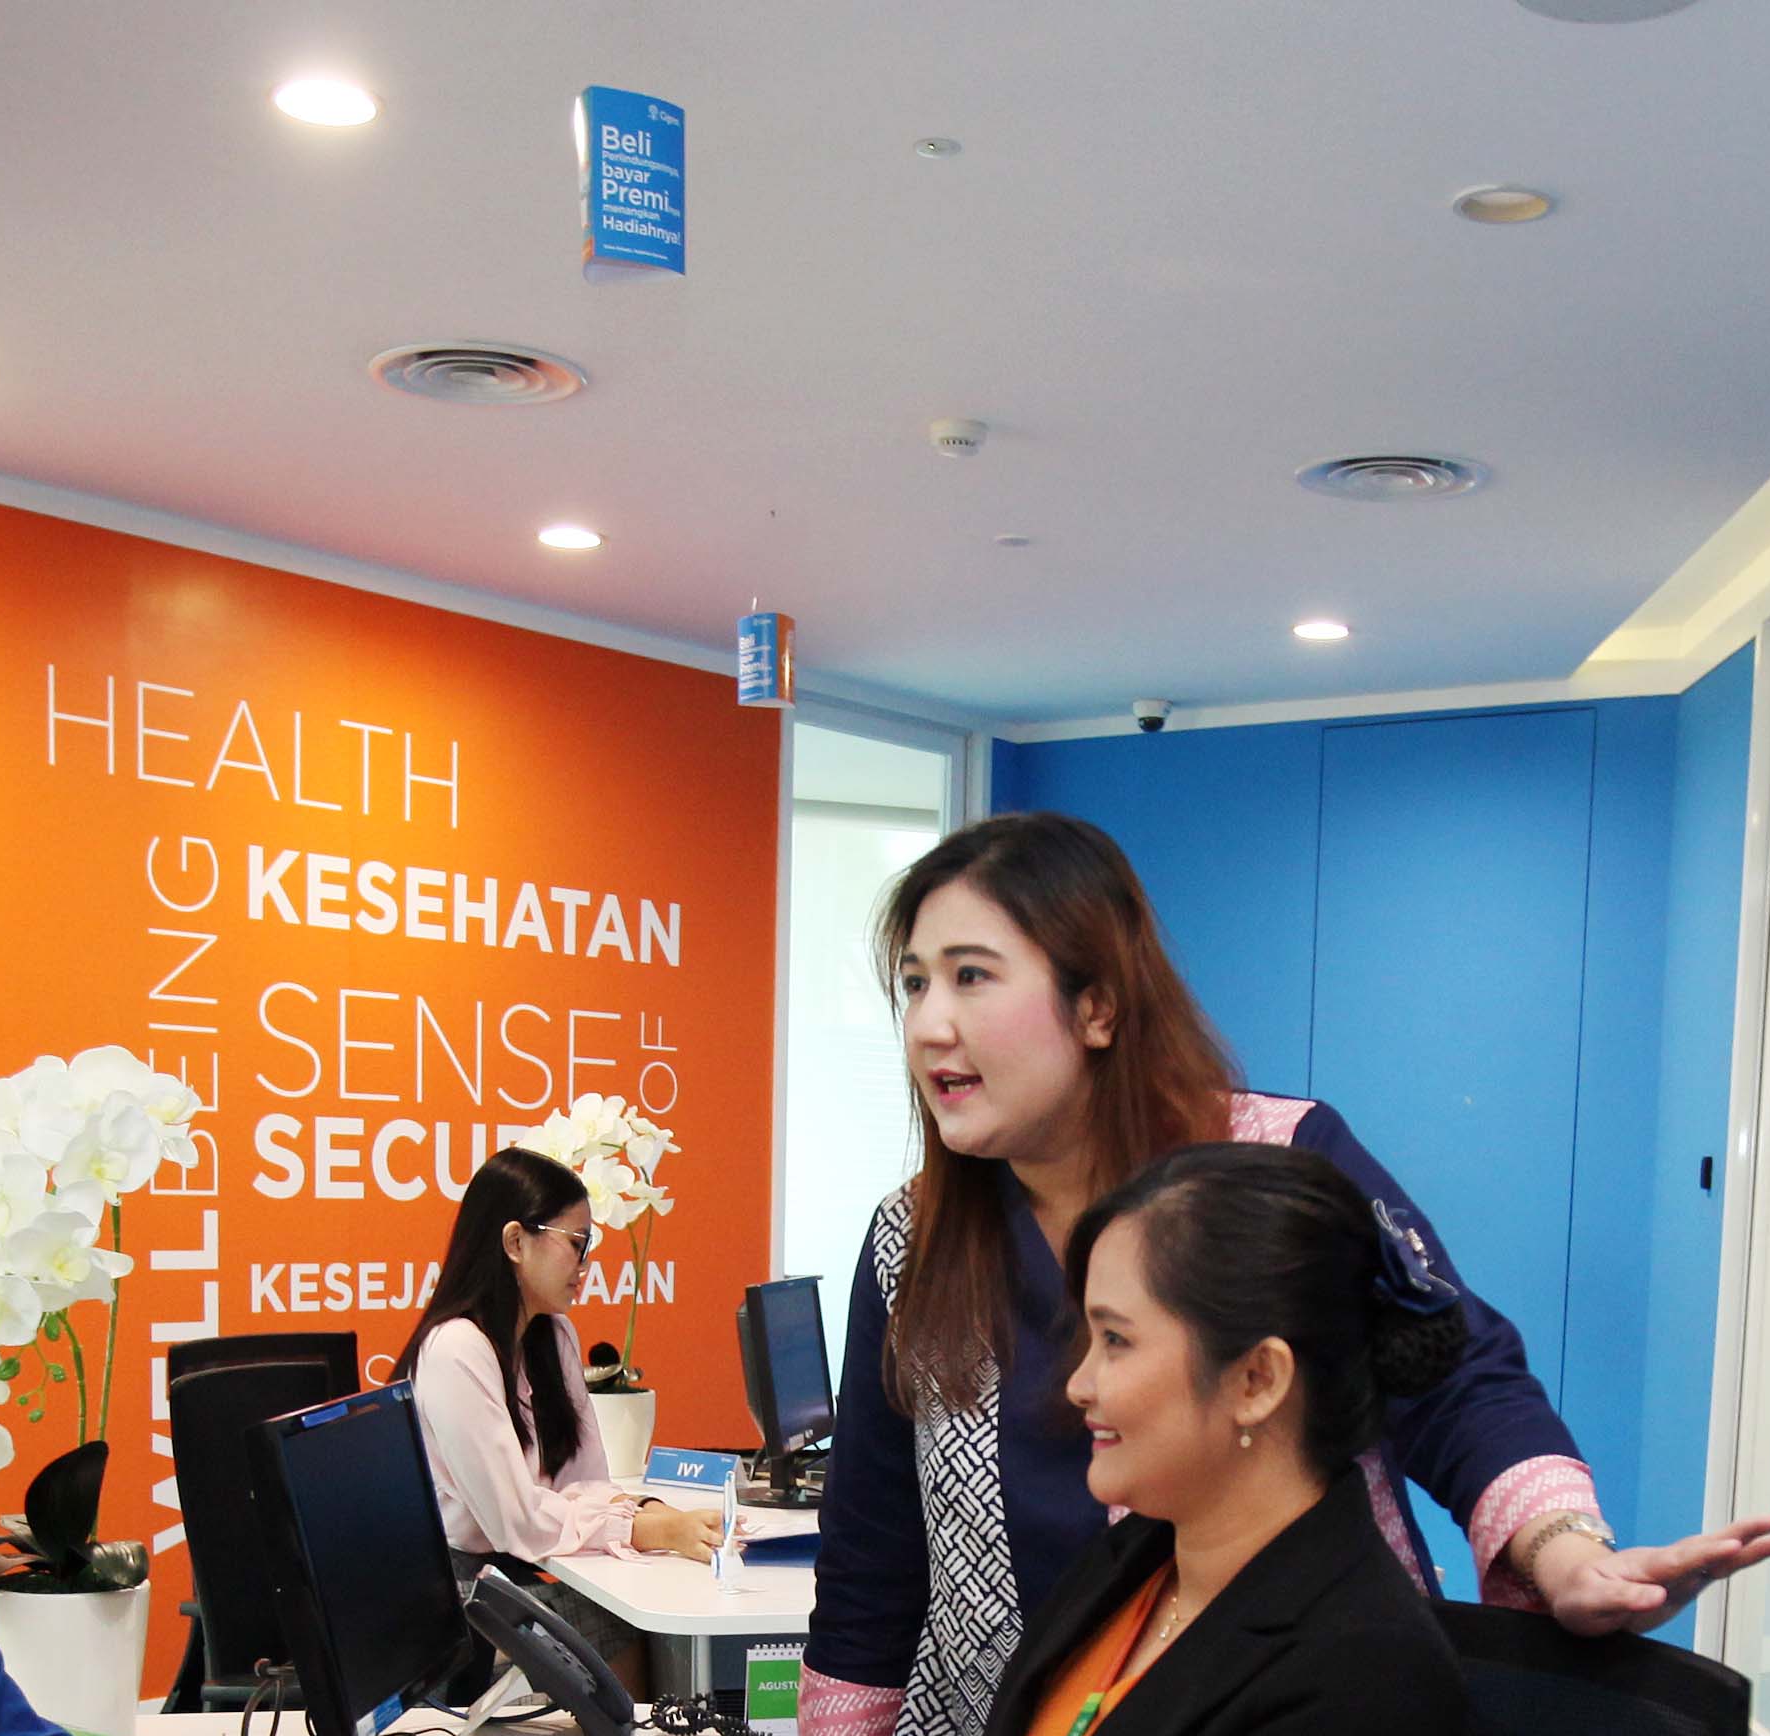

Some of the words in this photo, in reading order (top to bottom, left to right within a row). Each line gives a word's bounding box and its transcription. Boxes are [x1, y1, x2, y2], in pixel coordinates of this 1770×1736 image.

[601, 124, 652, 157] Beli
[602, 162, 650, 184] bayar
[46, 663, 459, 829] HEALTH
[247, 843, 681, 967] KESEHATAN
[255, 981, 622, 1110] SENSE
[639, 1011, 678, 1114] OF
[250, 1260, 676, 1313] KESEJAAAN
[677, 1462, 704, 1478] IVY
[757, 1680, 800, 1691] AGUSTU
